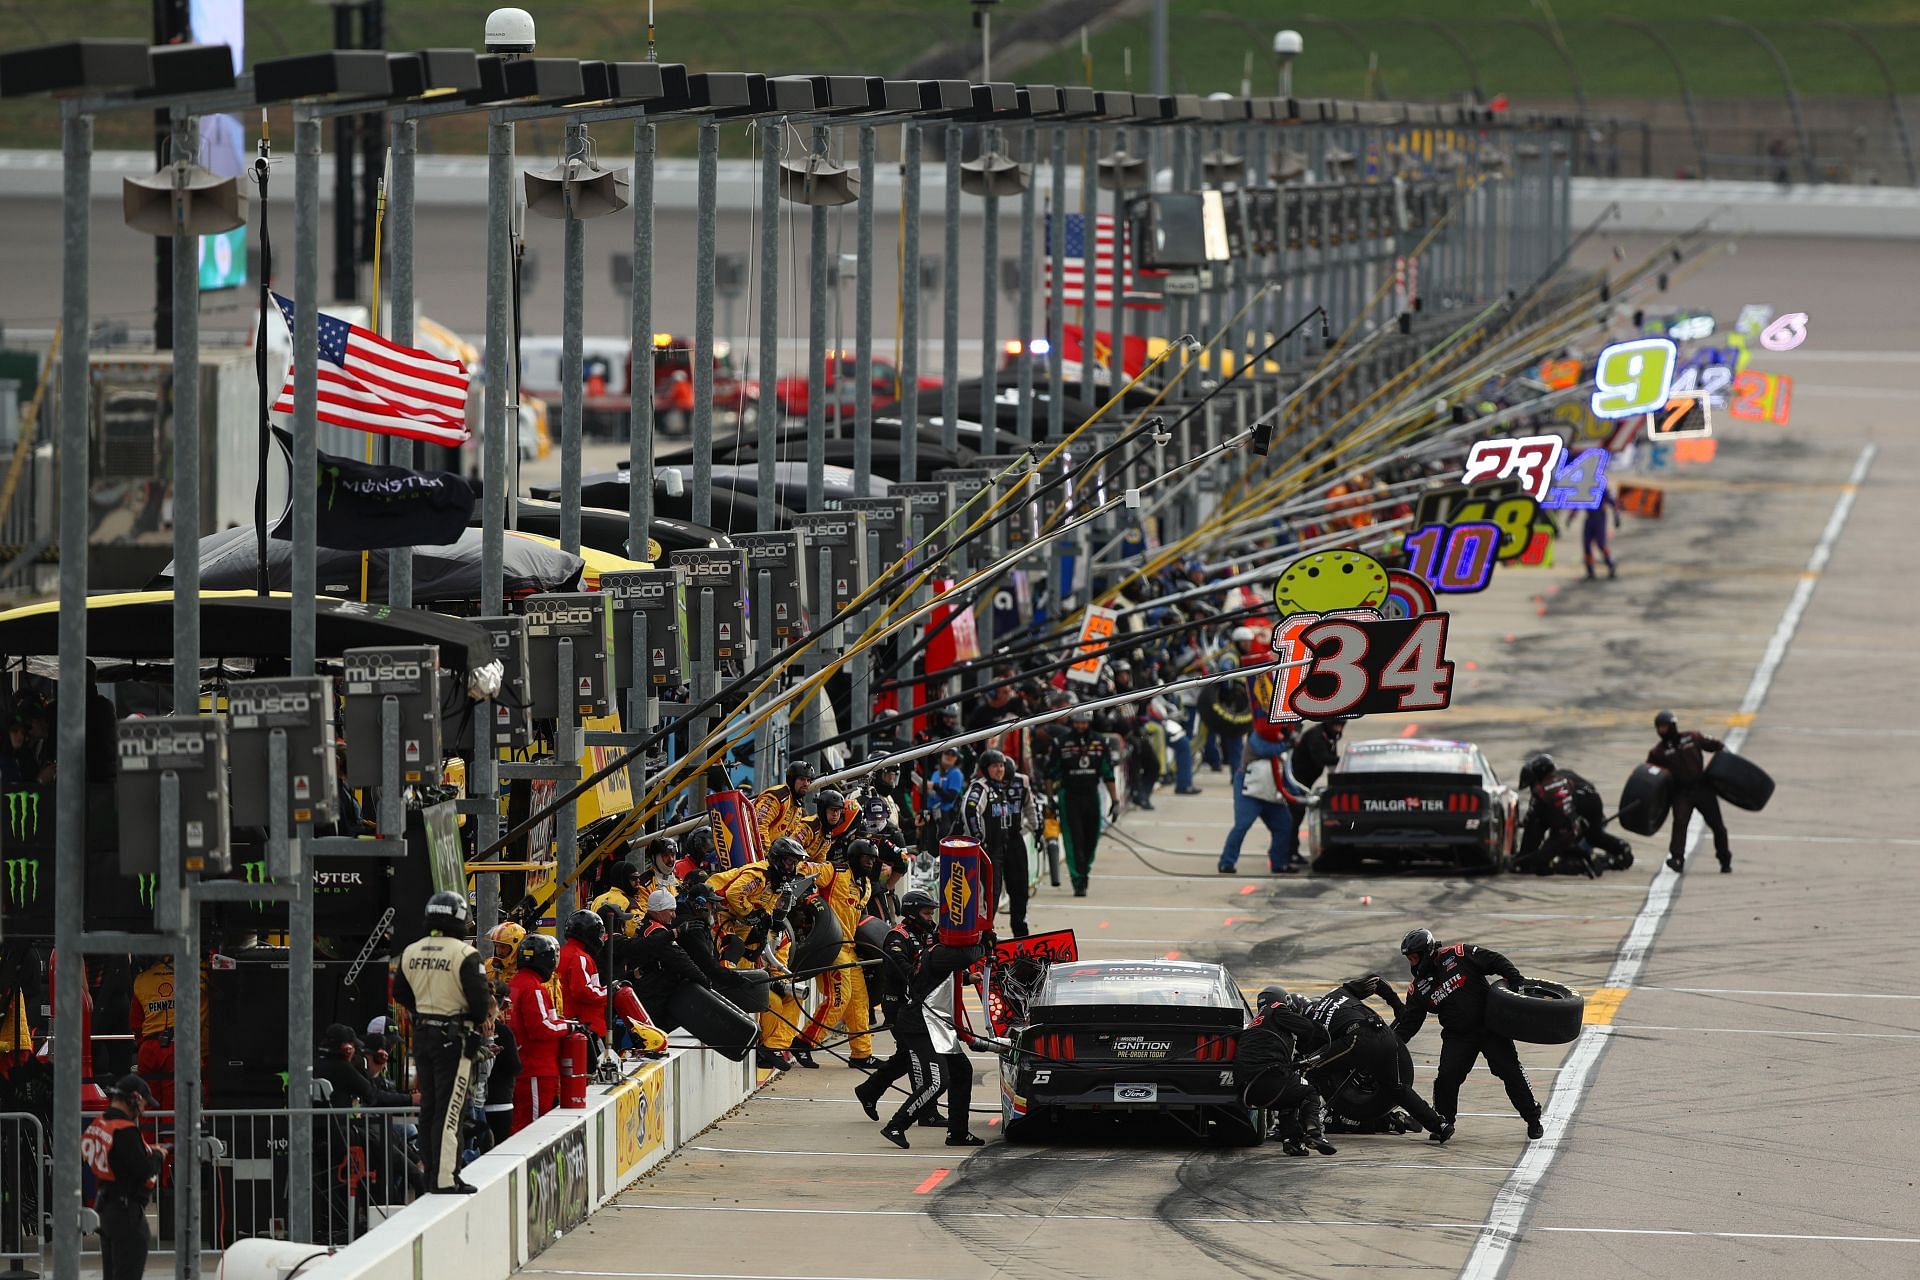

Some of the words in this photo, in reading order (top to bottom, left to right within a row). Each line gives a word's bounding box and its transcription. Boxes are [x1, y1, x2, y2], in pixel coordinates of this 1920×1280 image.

[1592, 338, 1677, 418] 9
[1730, 372, 1790, 426] 21
[1663, 397, 1695, 431] 7
[1461, 435, 1563, 503] 23
[1404, 525, 1500, 592] 10
[1289, 614, 1449, 716] 34
[711, 810, 731, 868] SUNOCO
[313, 870, 362, 885] NSTER
[951, 864, 964, 924] SUNOCO
[409, 957, 451, 972] OFFICIAL
[1108, 966, 1209, 975] motorsport
[148, 1000, 175, 1013] PENNZ
[1113, 1042, 1171, 1050] IGNITION
[446, 1076, 466, 1131] OFFICIAL
[1124, 1088, 1147, 1098] Ford
